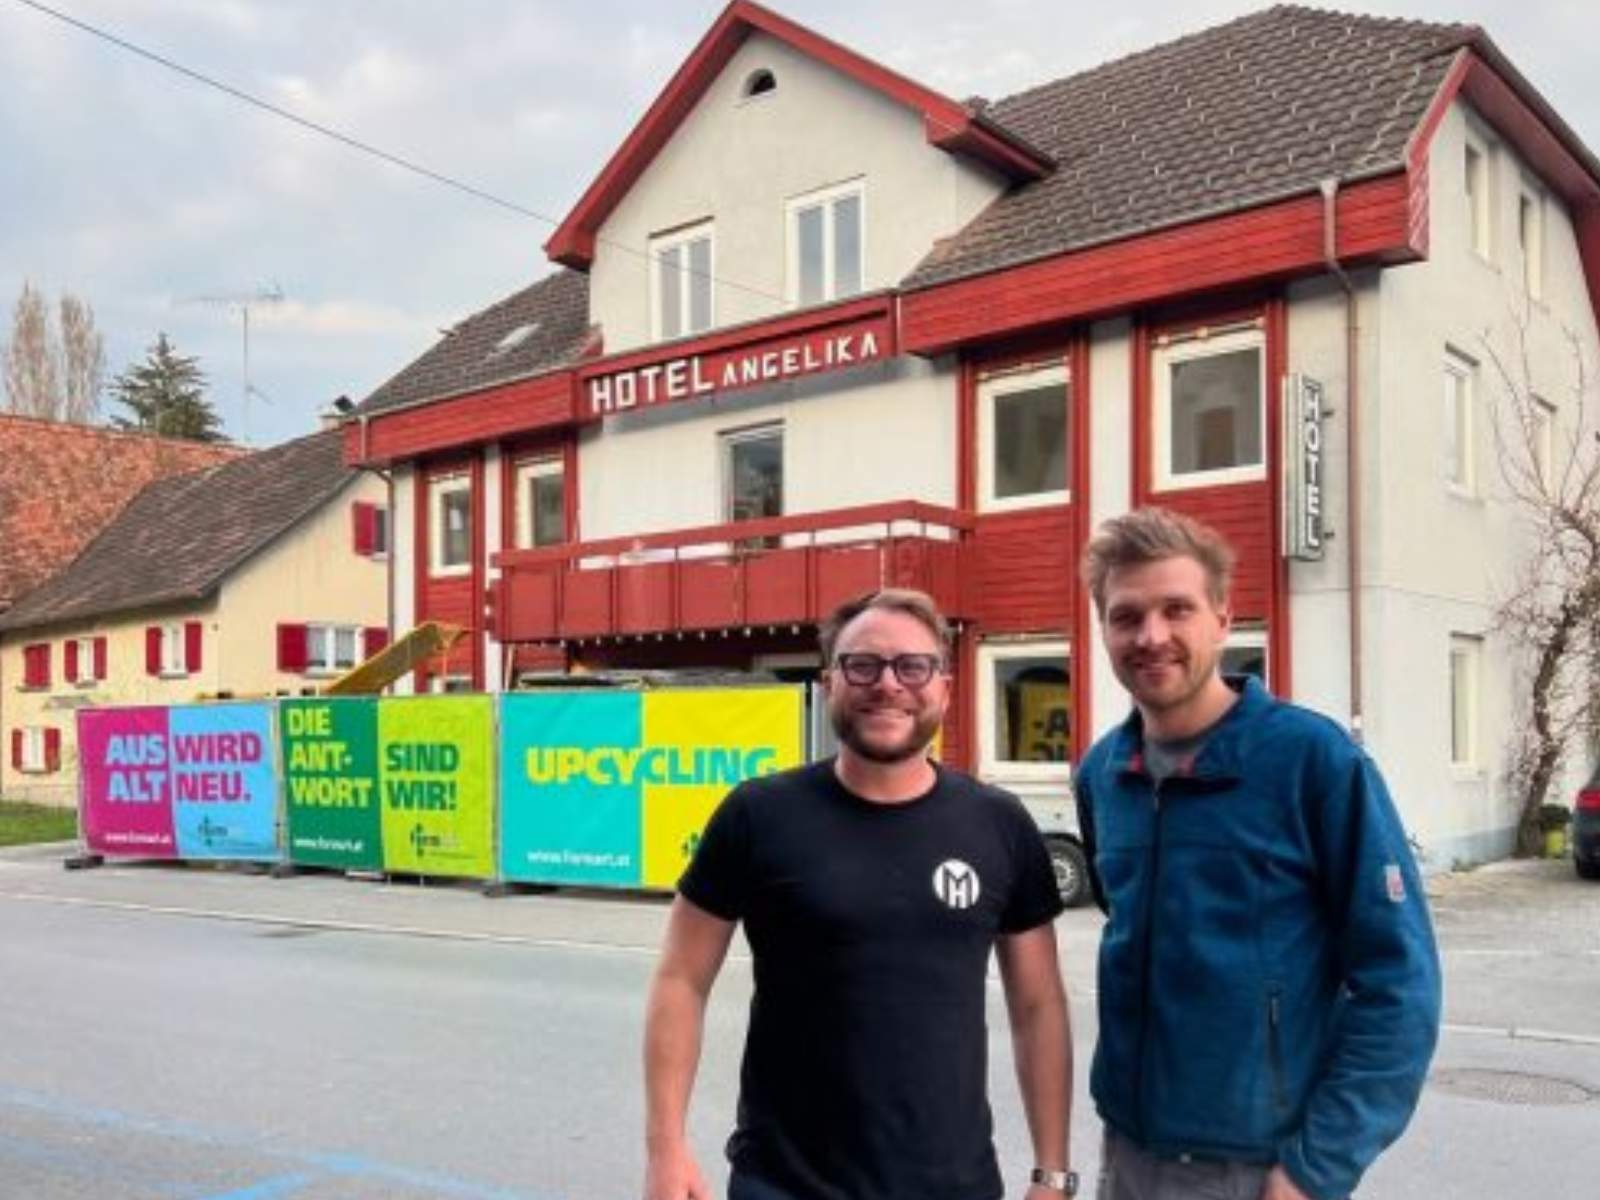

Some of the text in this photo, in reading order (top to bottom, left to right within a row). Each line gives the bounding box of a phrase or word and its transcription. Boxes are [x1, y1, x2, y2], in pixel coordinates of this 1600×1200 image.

[590, 331, 878, 412] HOTEL ANGELIKA
[1305, 389, 1321, 548] HOTEL
[287, 708, 332, 736] DIE
[105, 734, 166, 766] AUS
[173, 731, 262, 764] WIRD
[289, 742, 353, 772] ANT-
[386, 743, 459, 773] SIND
[108, 770, 166, 803] ALT
[175, 770, 252, 804] NEU.
[289, 777, 372, 808] WORT
[386, 780, 458, 811] WIR!
